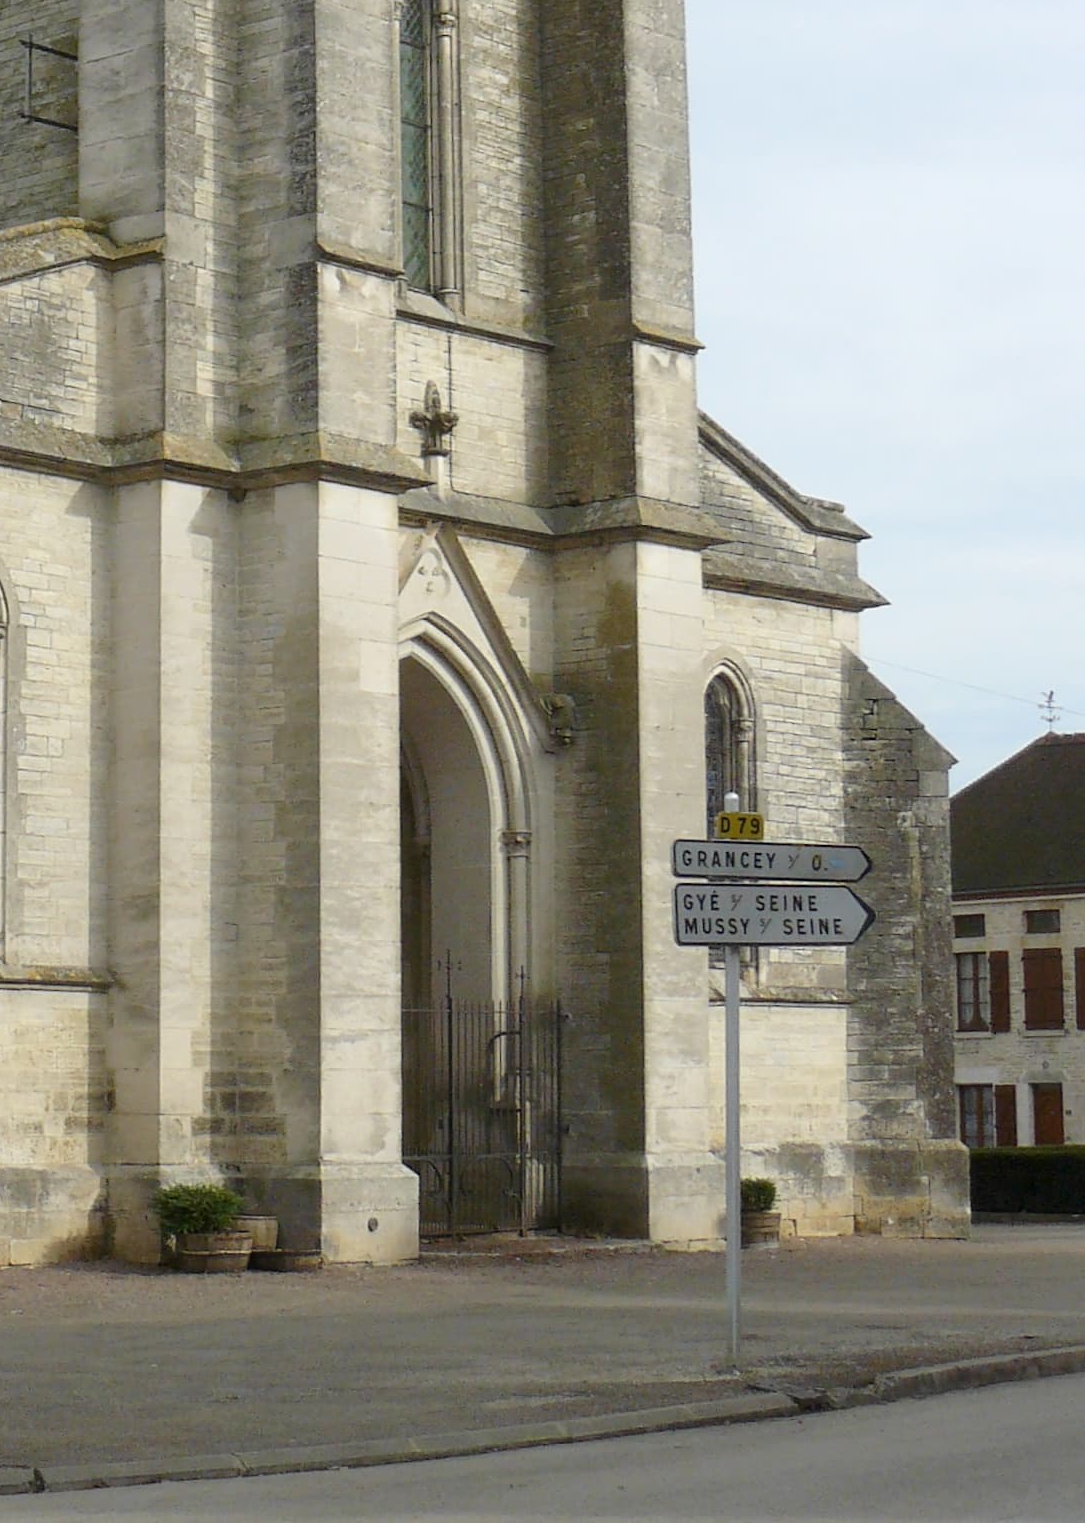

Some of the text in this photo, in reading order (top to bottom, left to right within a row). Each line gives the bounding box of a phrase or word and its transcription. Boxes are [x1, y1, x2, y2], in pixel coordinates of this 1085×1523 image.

[720, 817, 760, 835] D 79
[682, 850, 776, 869] GRANCEY
[683, 890, 720, 912] GYÉ
[755, 894, 818, 912] SEINE
[683, 917, 750, 936] MUSSY
[783, 918, 843, 936] SEINE
